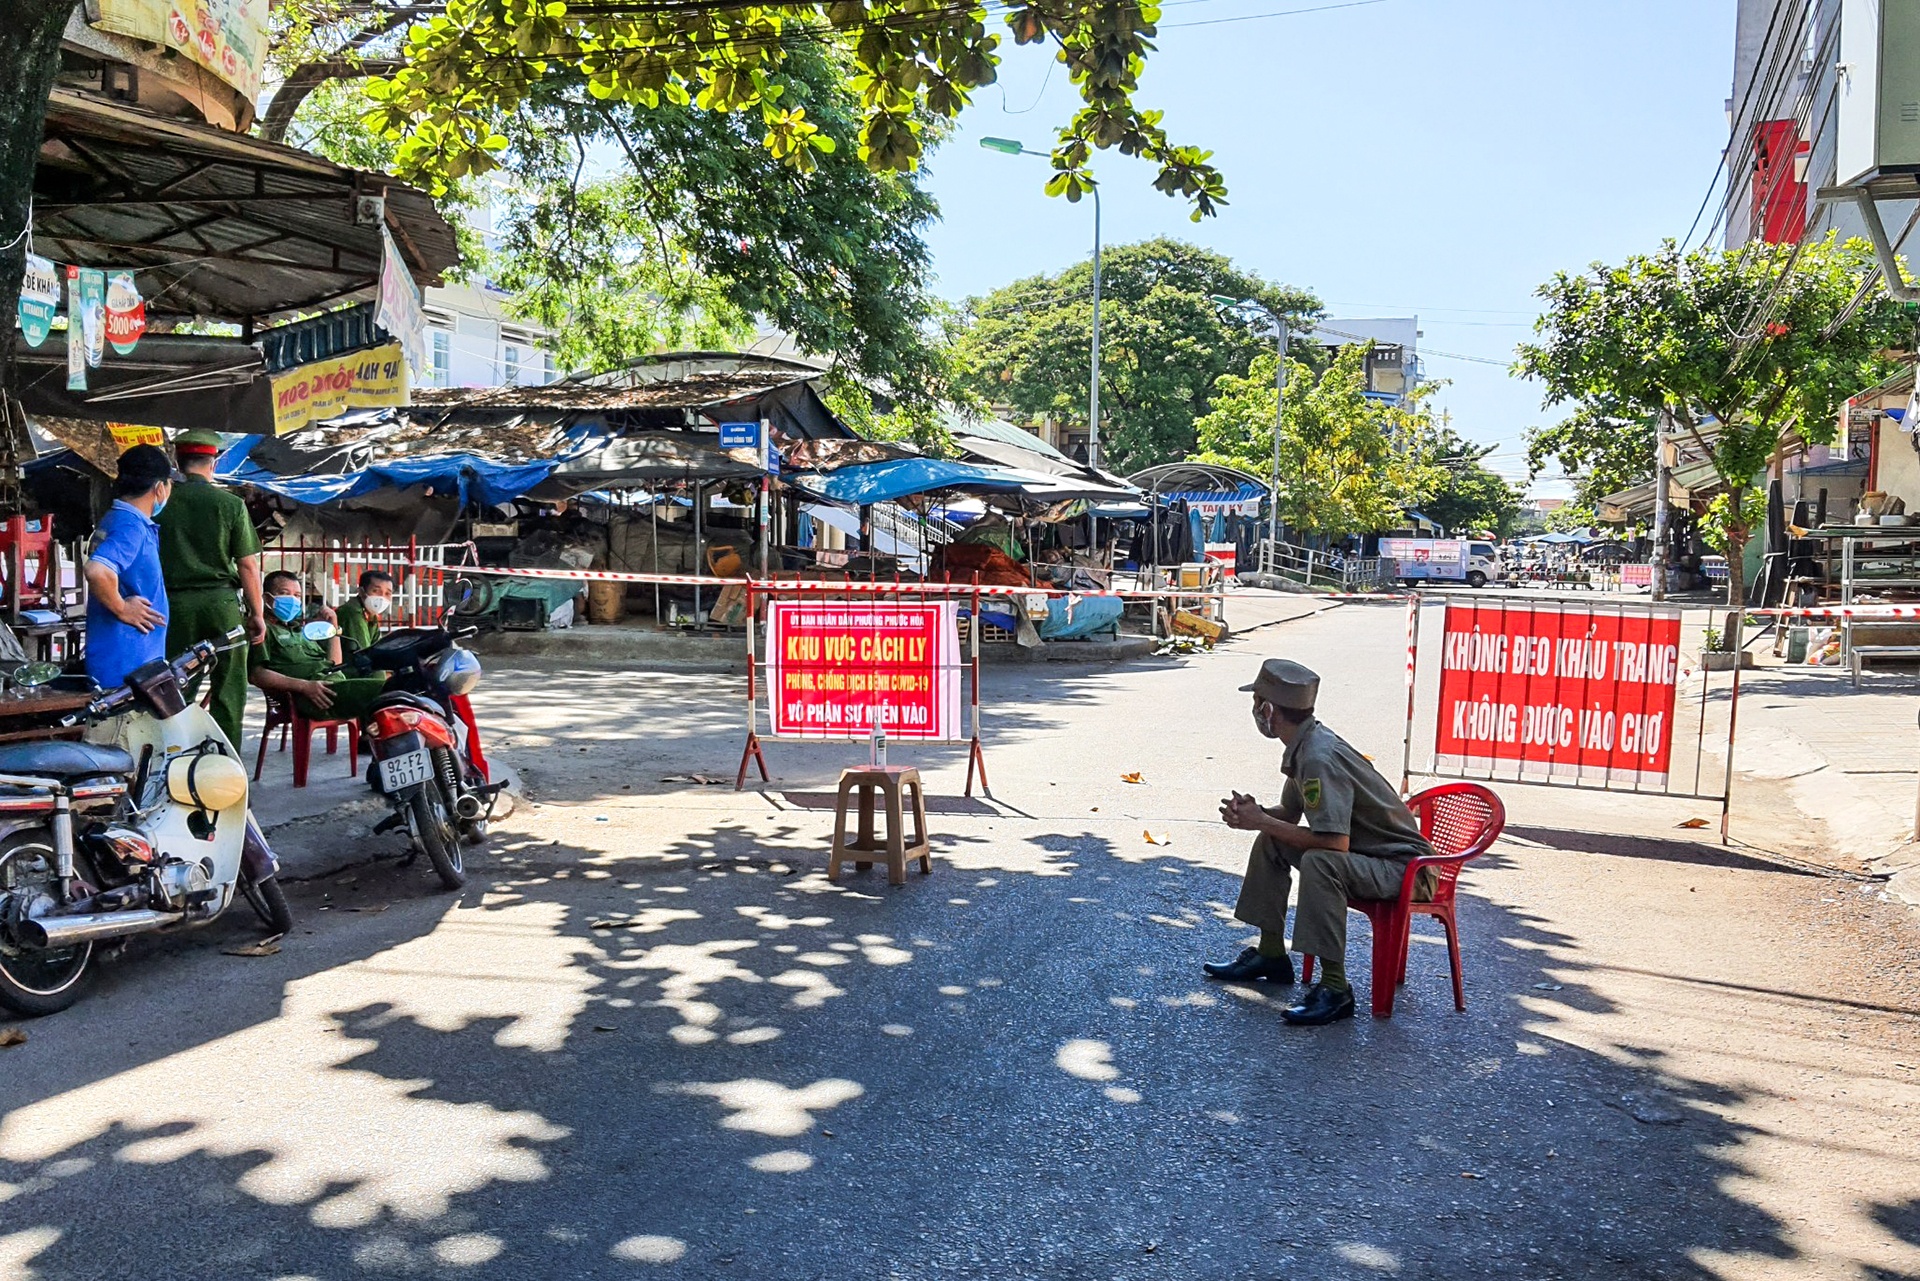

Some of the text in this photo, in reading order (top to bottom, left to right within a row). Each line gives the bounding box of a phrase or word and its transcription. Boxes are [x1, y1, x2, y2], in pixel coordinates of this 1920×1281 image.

[801, 614, 815, 626] BAN
[816, 612, 837, 626] NHÂN
[838, 612, 851, 626] DÂN
[787, 632, 928, 666] KHU VỰC CÁCH LY
[1443, 623, 1678, 685] KHÔNG ĐEO KHẨU TRANG
[786, 669, 929, 694] PHÒNG, CHỐNG DỊCH BỆNH COVID-19
[788, 698, 928, 728] VÔ PHẬN SỰ MIỄN VÀO
[1452, 694, 1664, 764] KHÔNG ĐƯỢC VÀO CHỢ
[387, 753, 423, 774] 92-F2
[390, 766, 425, 788] 9017
